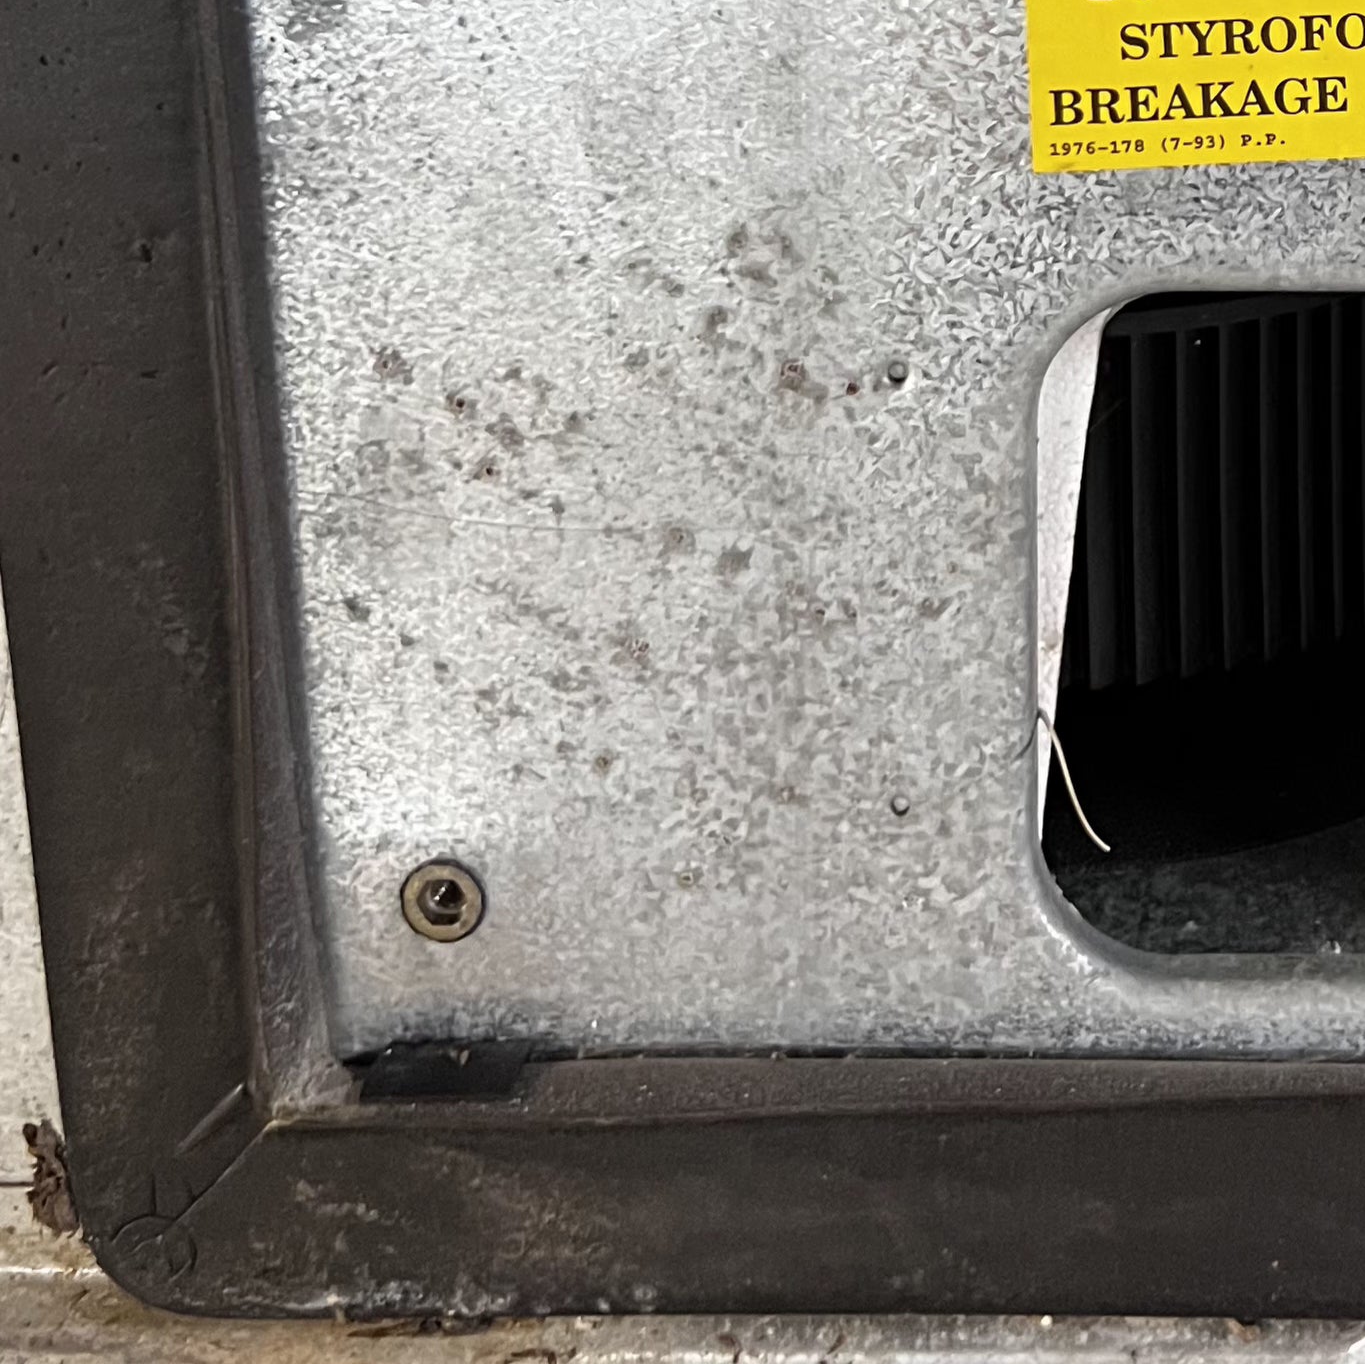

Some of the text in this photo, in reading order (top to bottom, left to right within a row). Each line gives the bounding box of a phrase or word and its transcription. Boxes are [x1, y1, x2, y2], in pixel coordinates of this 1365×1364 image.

[1050, 77, 1347, 125] BREAKAGE
[1050, 133, 1285, 156] 1976-178 (7-93) P.P.
